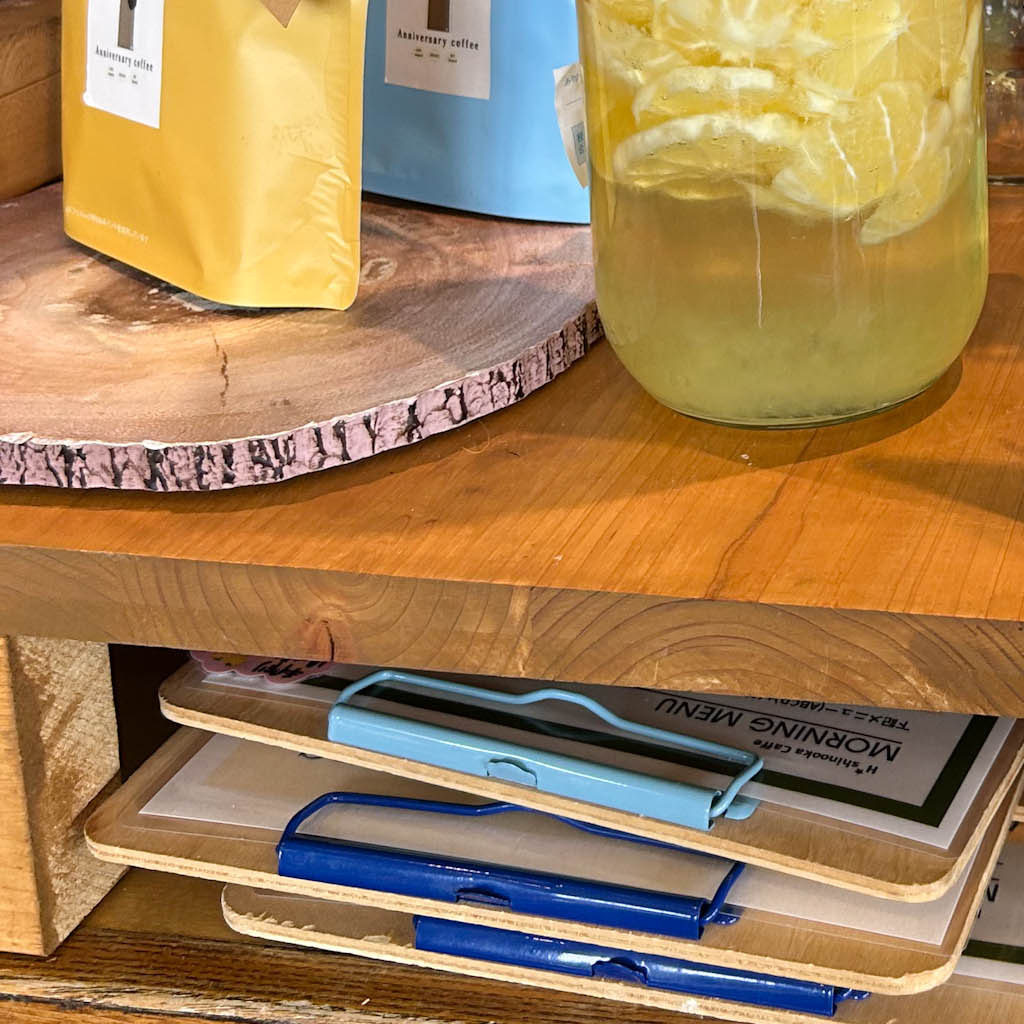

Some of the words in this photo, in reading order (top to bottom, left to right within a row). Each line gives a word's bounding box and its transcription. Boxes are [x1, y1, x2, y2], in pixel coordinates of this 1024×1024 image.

[397, 29, 447, 49] Anniversary
[450, 38, 480, 51] coffee
[95, 45, 132, 68] Anniversary
[133, 57, 154, 72] coffee
[655, 697, 743, 727] MENU
[751, 717, 901, 762] MORNING
[753, 738, 792, 754] Caffe
